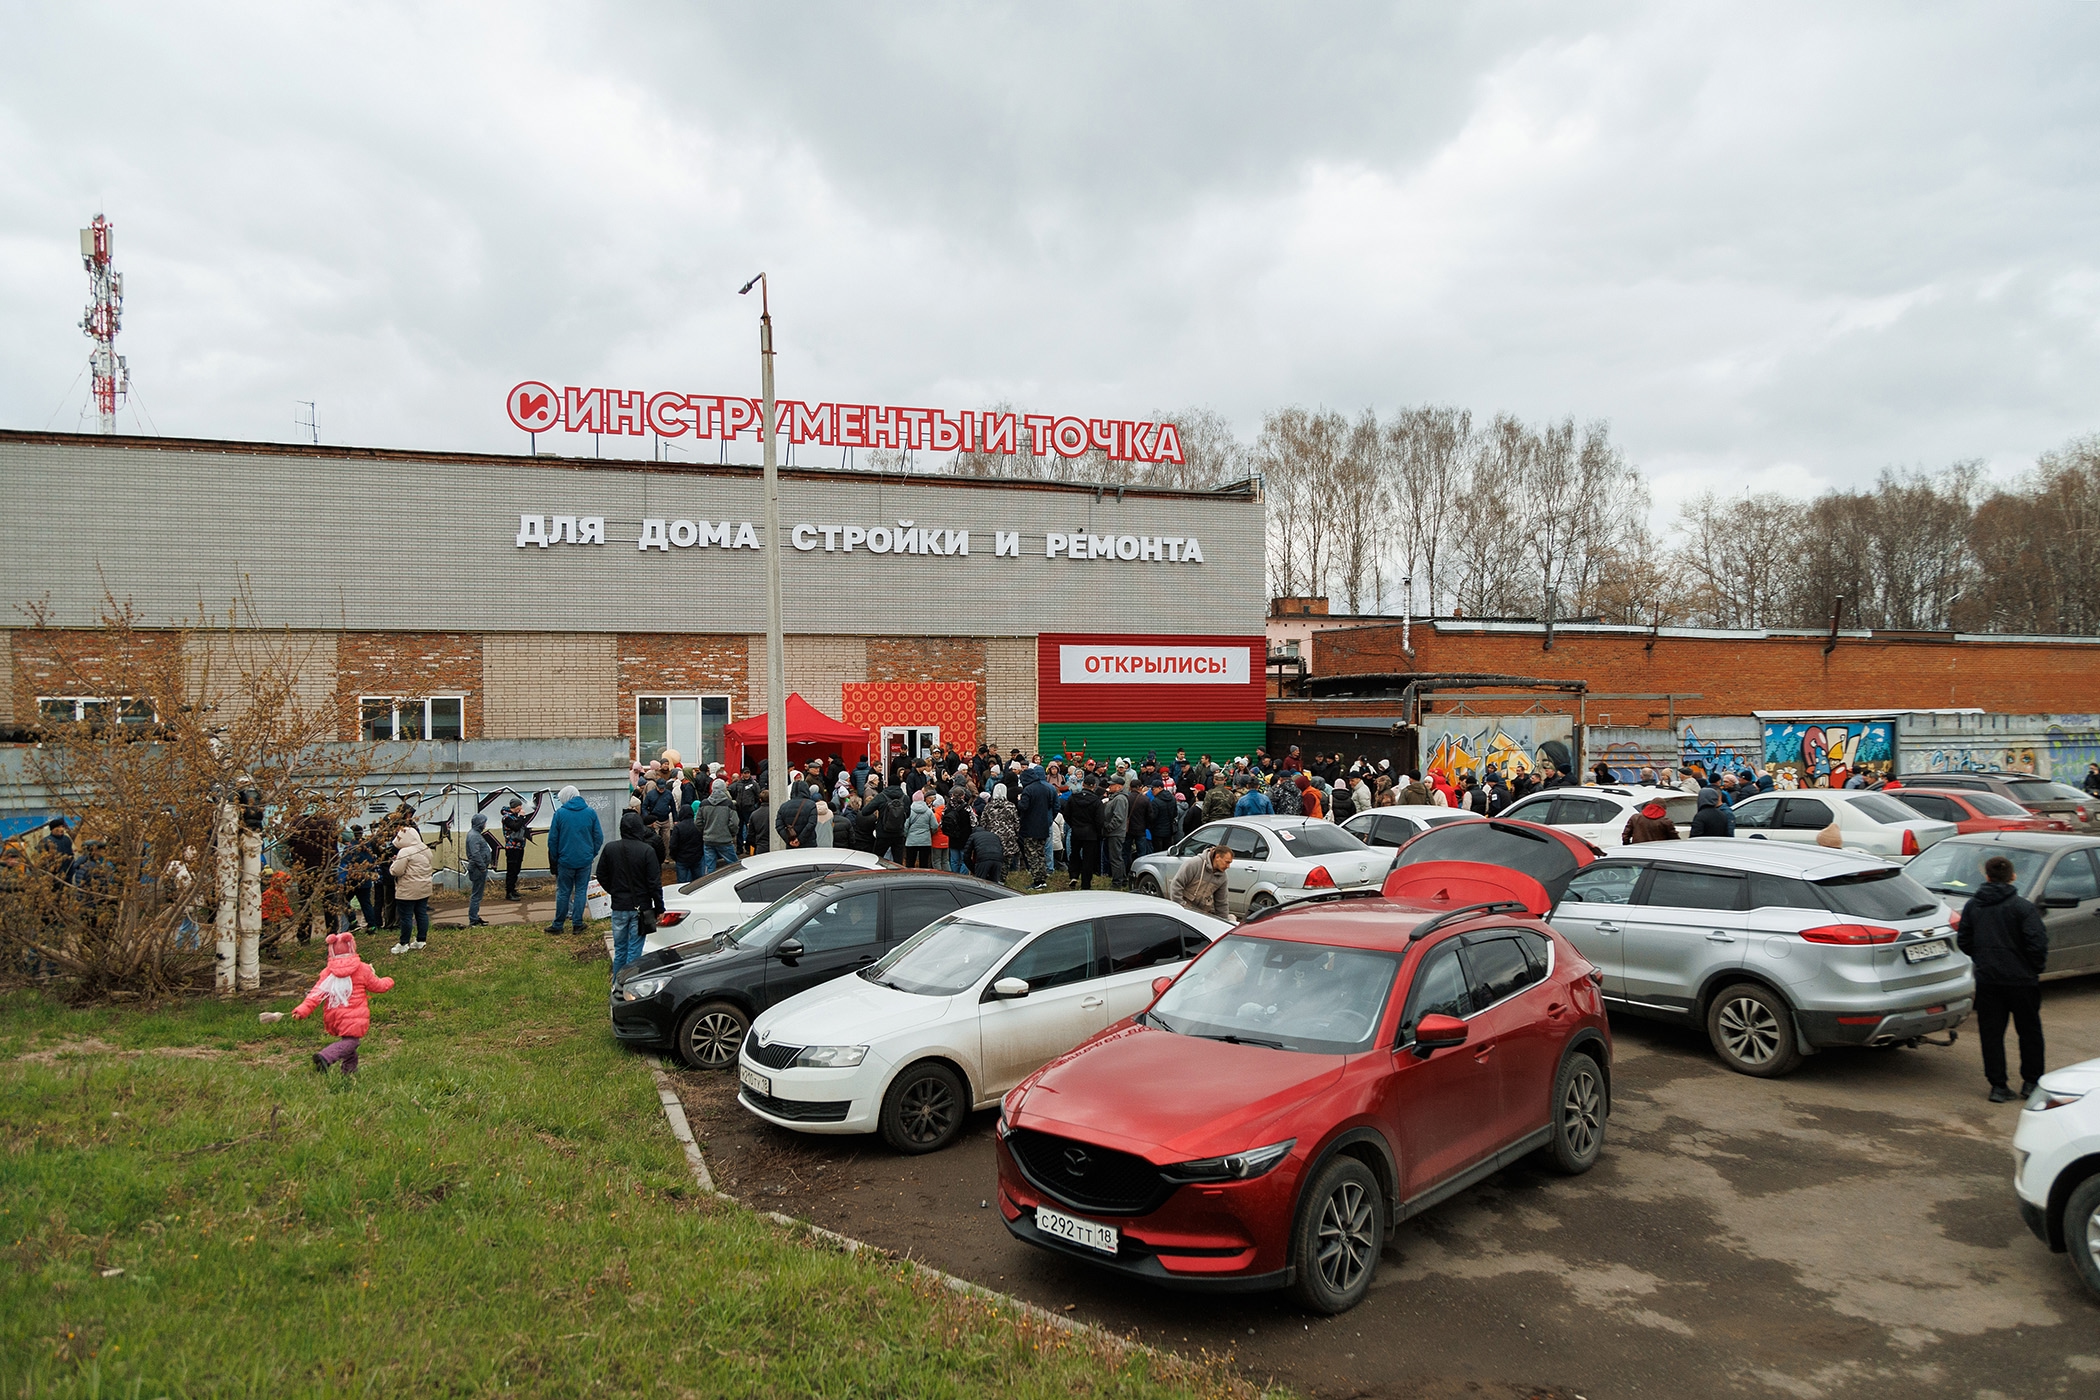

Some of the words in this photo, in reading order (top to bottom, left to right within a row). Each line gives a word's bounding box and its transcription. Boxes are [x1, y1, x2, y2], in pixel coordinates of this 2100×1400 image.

[564, 386, 975, 453] ИНСТРУМЕНТЫ
[983, 411, 1017, 455] И
[1024, 413, 1186, 464] ТОЧКА
[516, 514, 605, 549] ДЛЯ
[638, 518, 761, 552] ДОМА
[791, 519, 969, 556] СТРОЙКИ
[995, 530, 1020, 557] И
[1046, 532, 1204, 563] РЕМОНТА
[1084, 655, 1228, 674] ОТКРЫЛИСЬ!
[1041, 1214, 1092, 1243] С292ТТ
[1097, 1228, 1112, 1243] 18
